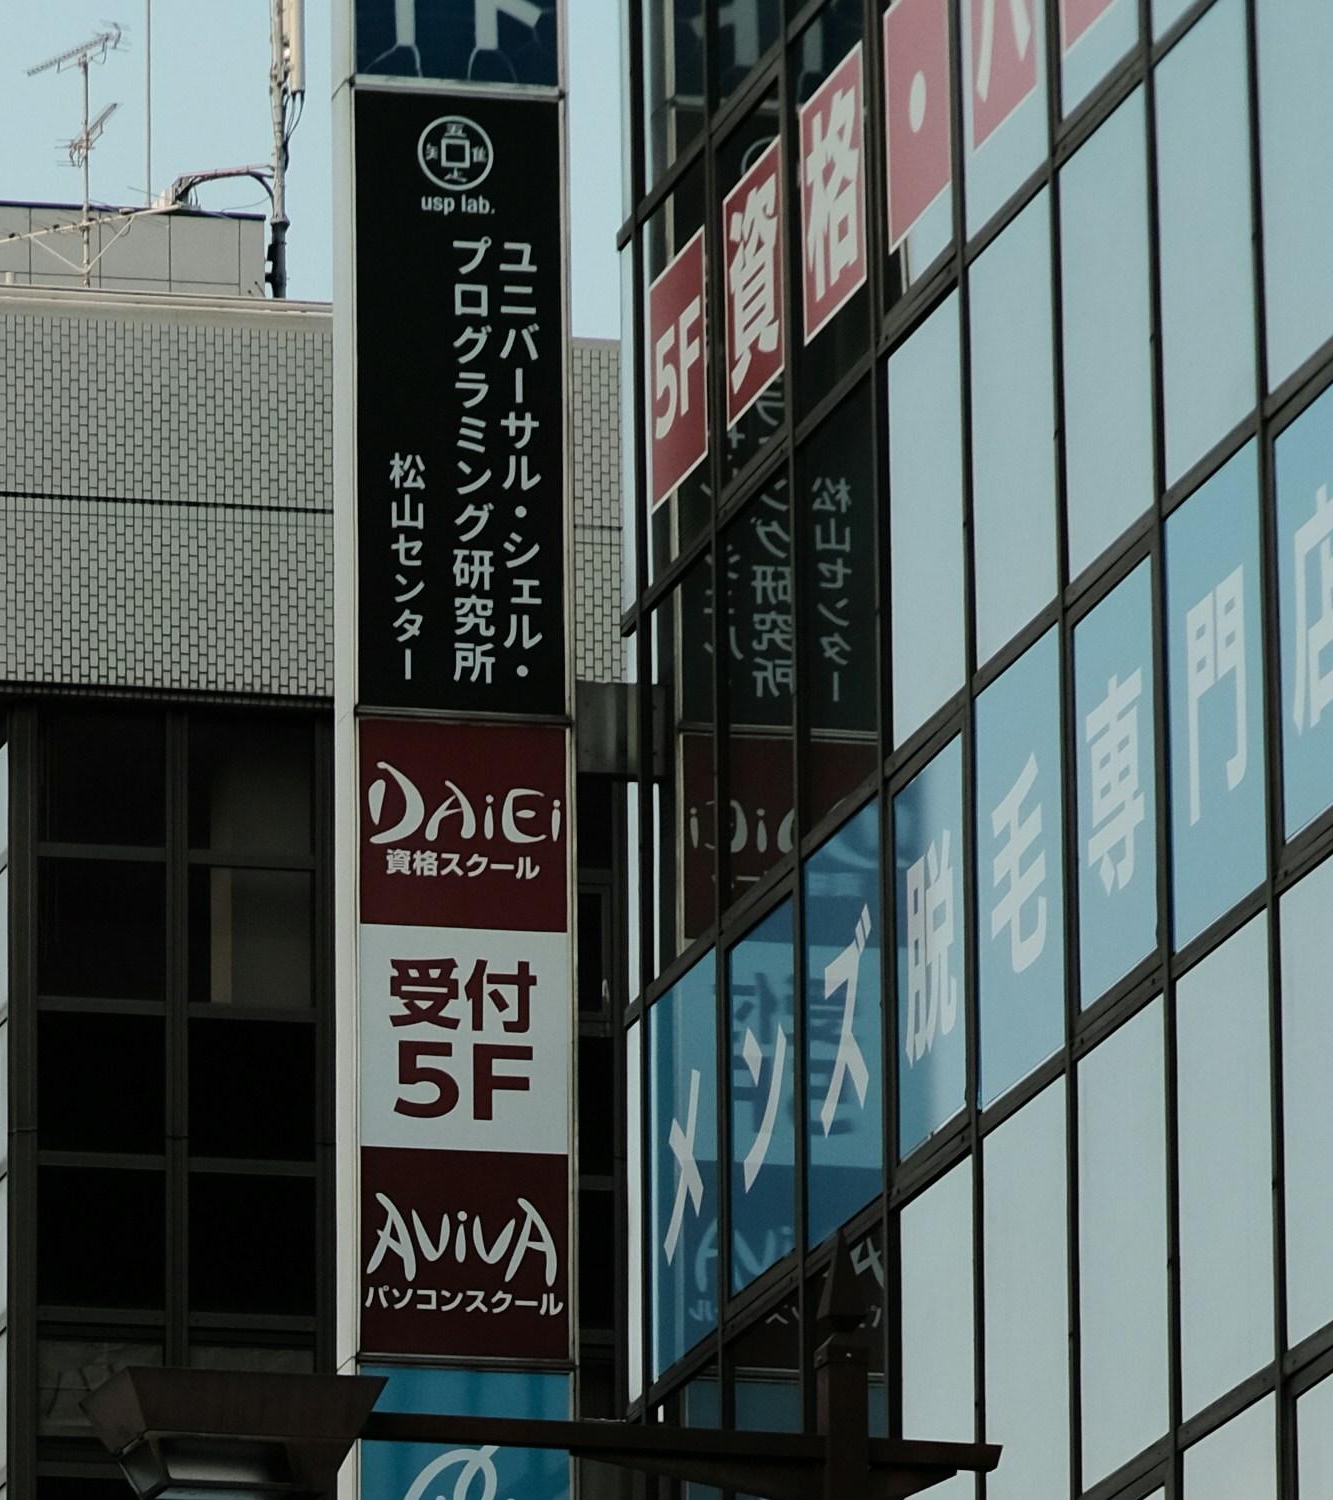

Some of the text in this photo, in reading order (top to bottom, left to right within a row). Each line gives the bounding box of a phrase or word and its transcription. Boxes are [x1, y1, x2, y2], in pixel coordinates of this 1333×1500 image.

[421, 194, 495, 215] usp lab.
[655, 296, 700, 439] 5F
[452, 236, 495, 683] プログラミング研究所
[389, 452, 426, 680] 松山センター
[386, 847, 540, 880] 資格スクール
[389, 957, 537, 1034] 受付
[393, 1040, 534, 1121] 5F
[365, 1285, 564, 1316] パソコンスクール
